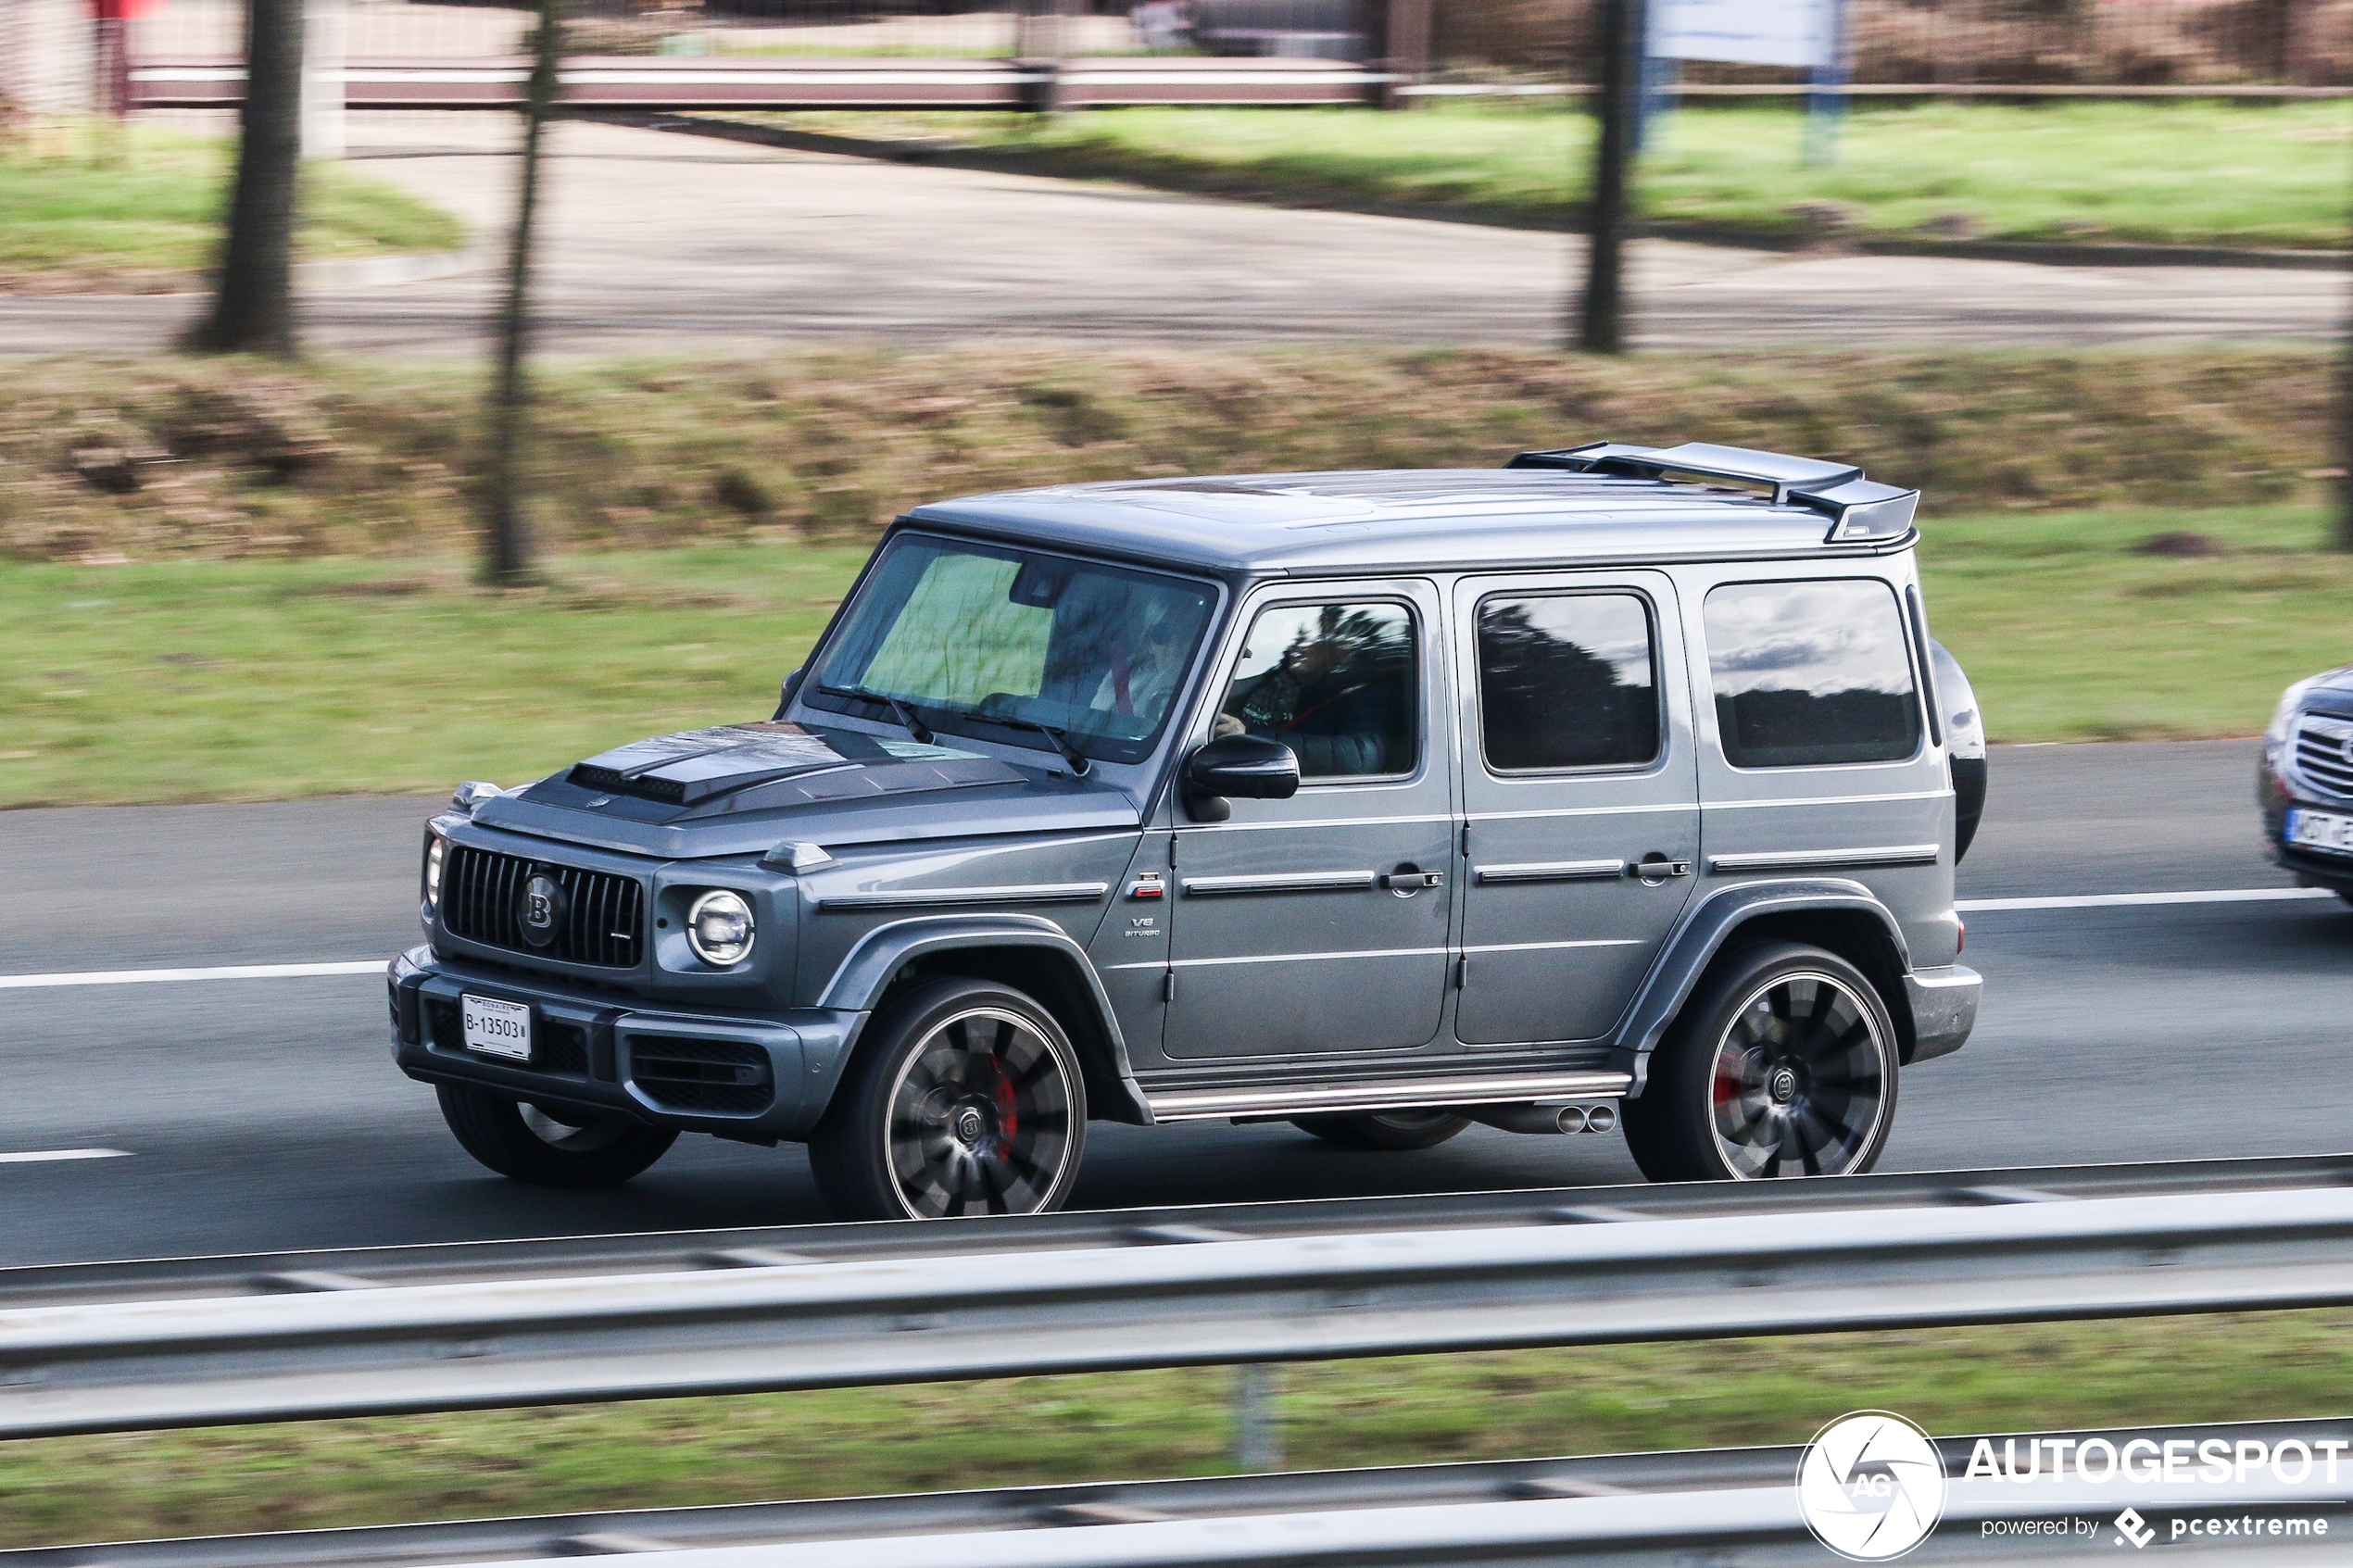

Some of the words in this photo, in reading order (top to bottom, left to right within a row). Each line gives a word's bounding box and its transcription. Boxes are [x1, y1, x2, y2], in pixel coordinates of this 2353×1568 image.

[1131, 918, 1153, 927] V8
[1125, 929, 1160, 937] BITURBO
[466, 1013, 519, 1038] B-13503
